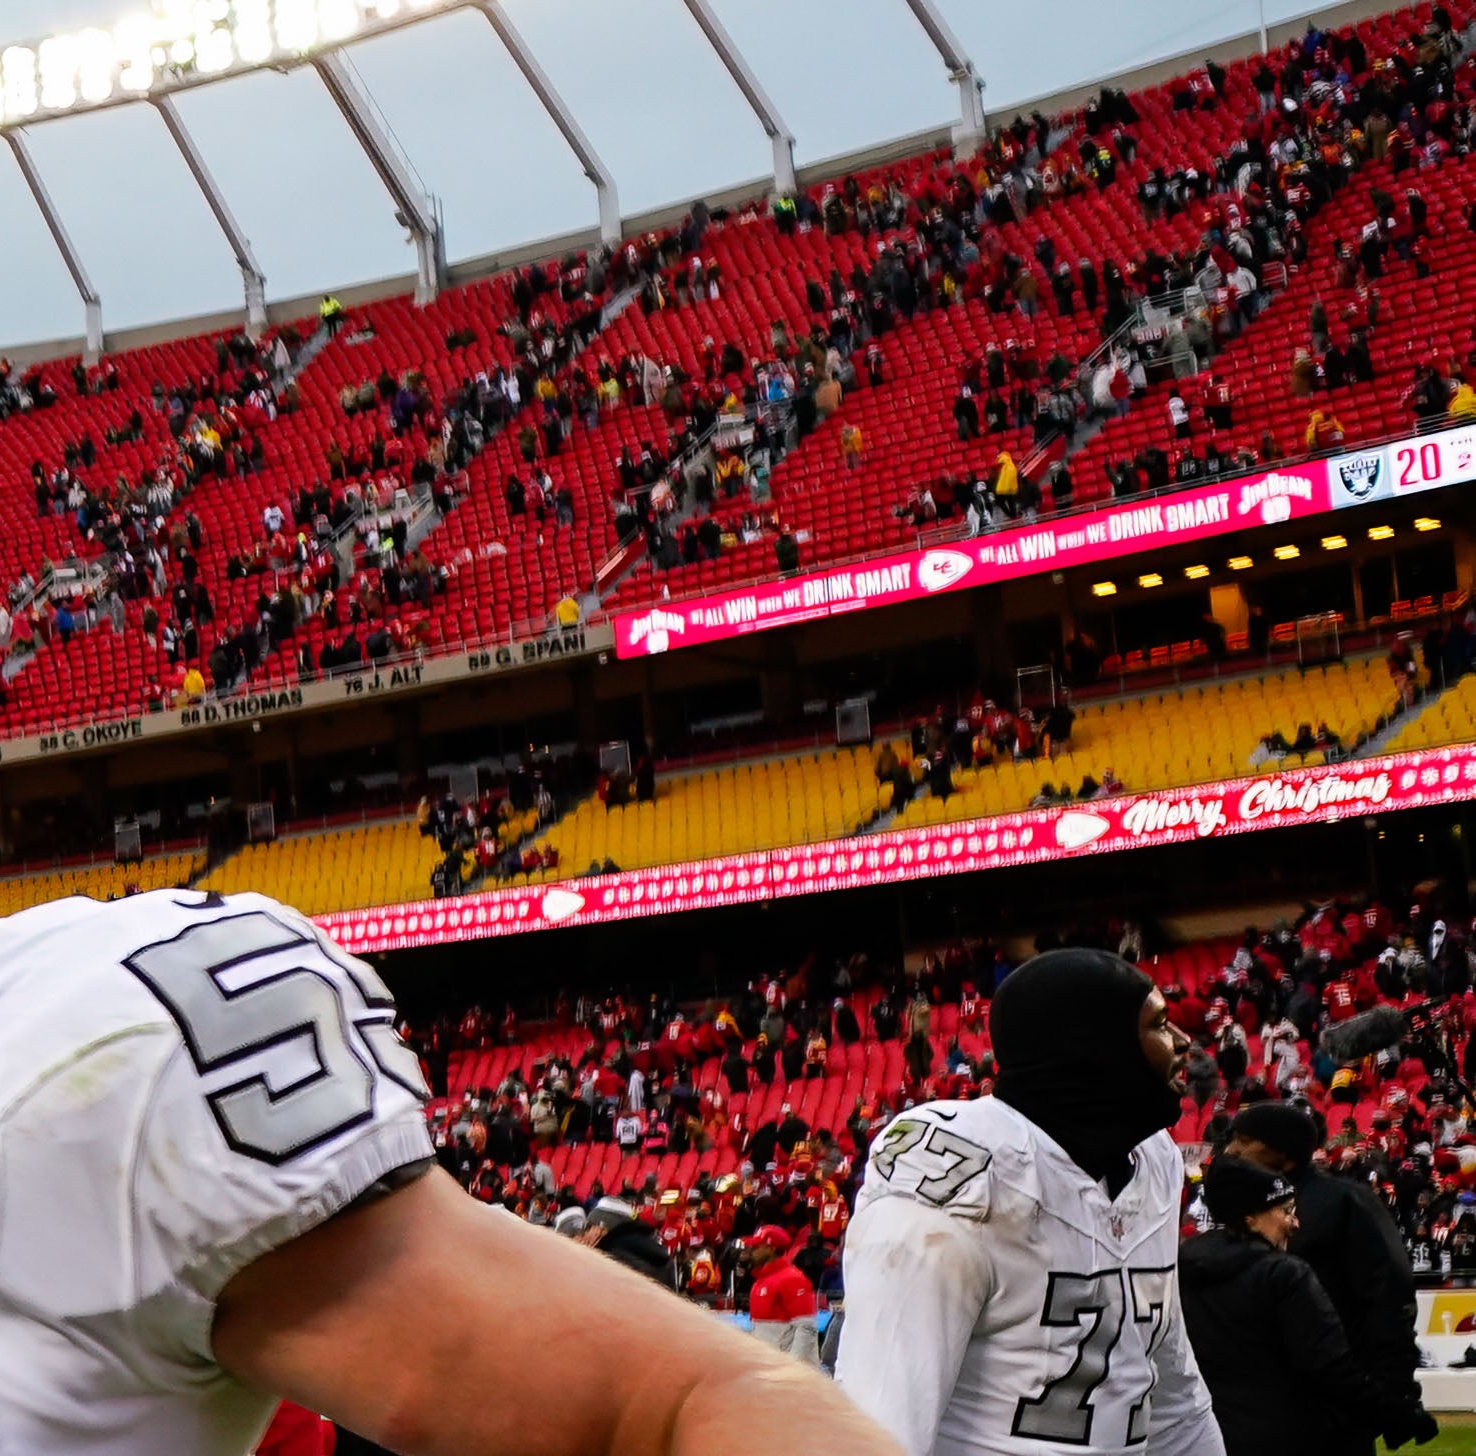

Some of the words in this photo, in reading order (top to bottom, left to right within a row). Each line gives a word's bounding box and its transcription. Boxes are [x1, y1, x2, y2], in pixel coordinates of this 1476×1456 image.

[1397, 443, 1441, 486] 20
[997, 544, 1019, 565] ALL
[1019, 531, 1056, 562] WIN
[1109, 505, 1164, 541] DRINK
[1165, 493, 1229, 532] SMART
[705, 606, 724, 628] ALL
[725, 596, 758, 624] WIN
[803, 572, 854, 607] DRINK
[855, 563, 911, 598] SMART
[390, 665, 424, 685] ALT
[84, 720, 142, 746] OKOYE
[1122, 798, 1226, 837] Merry
[1239, 772, 1392, 819] Christmas
[872, 1118, 992, 1204] 77
[1011, 1264, 1177, 1447] 77
